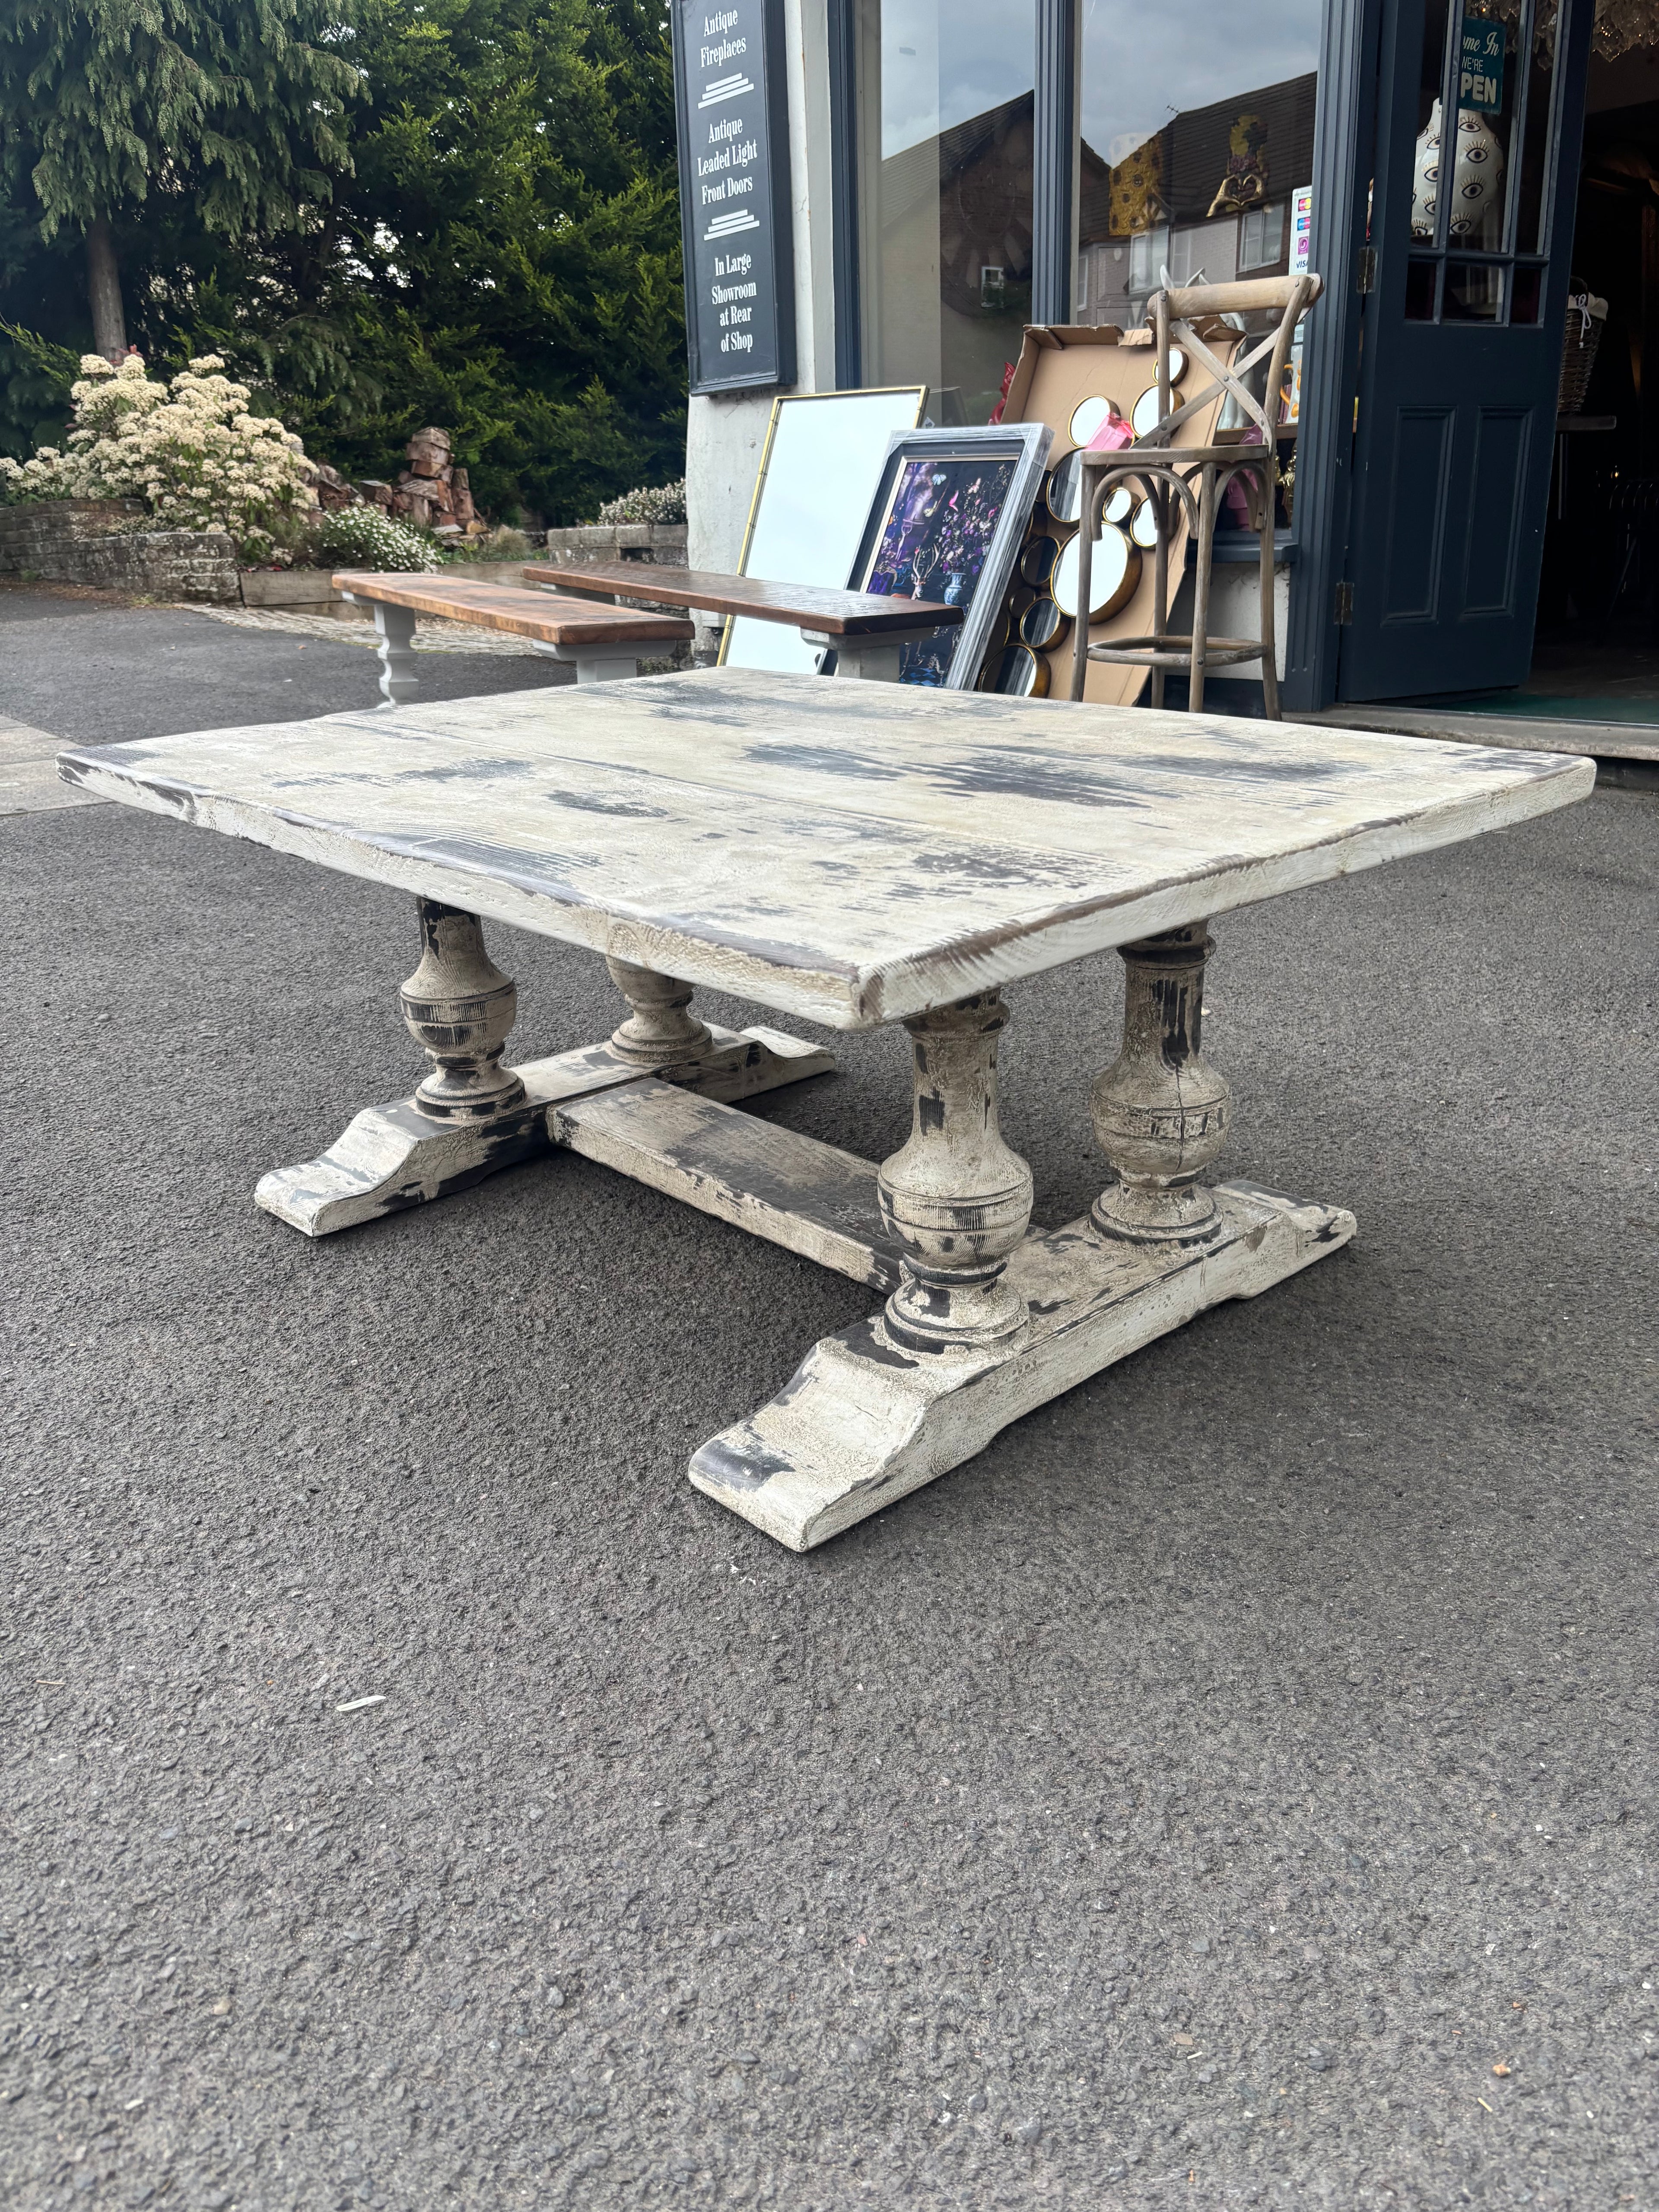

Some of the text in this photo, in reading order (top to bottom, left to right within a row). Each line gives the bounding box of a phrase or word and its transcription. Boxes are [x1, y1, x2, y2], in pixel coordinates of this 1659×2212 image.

[704, 10, 737, 37] Antique
[700, 38, 746, 67] Fireplaces
[1463, 32, 1500, 56] me In
[1460, 72, 1497, 104] PEN
[709, 118, 743, 143] Antique
[697, 139, 757, 176] Leaded Light
[702, 176, 753, 205] Front Doors
[715, 254, 751, 276] In Large
[712, 282, 757, 305] Showroom
[720, 306, 752, 327] at Rear
[721, 331, 753, 353] of Shop
